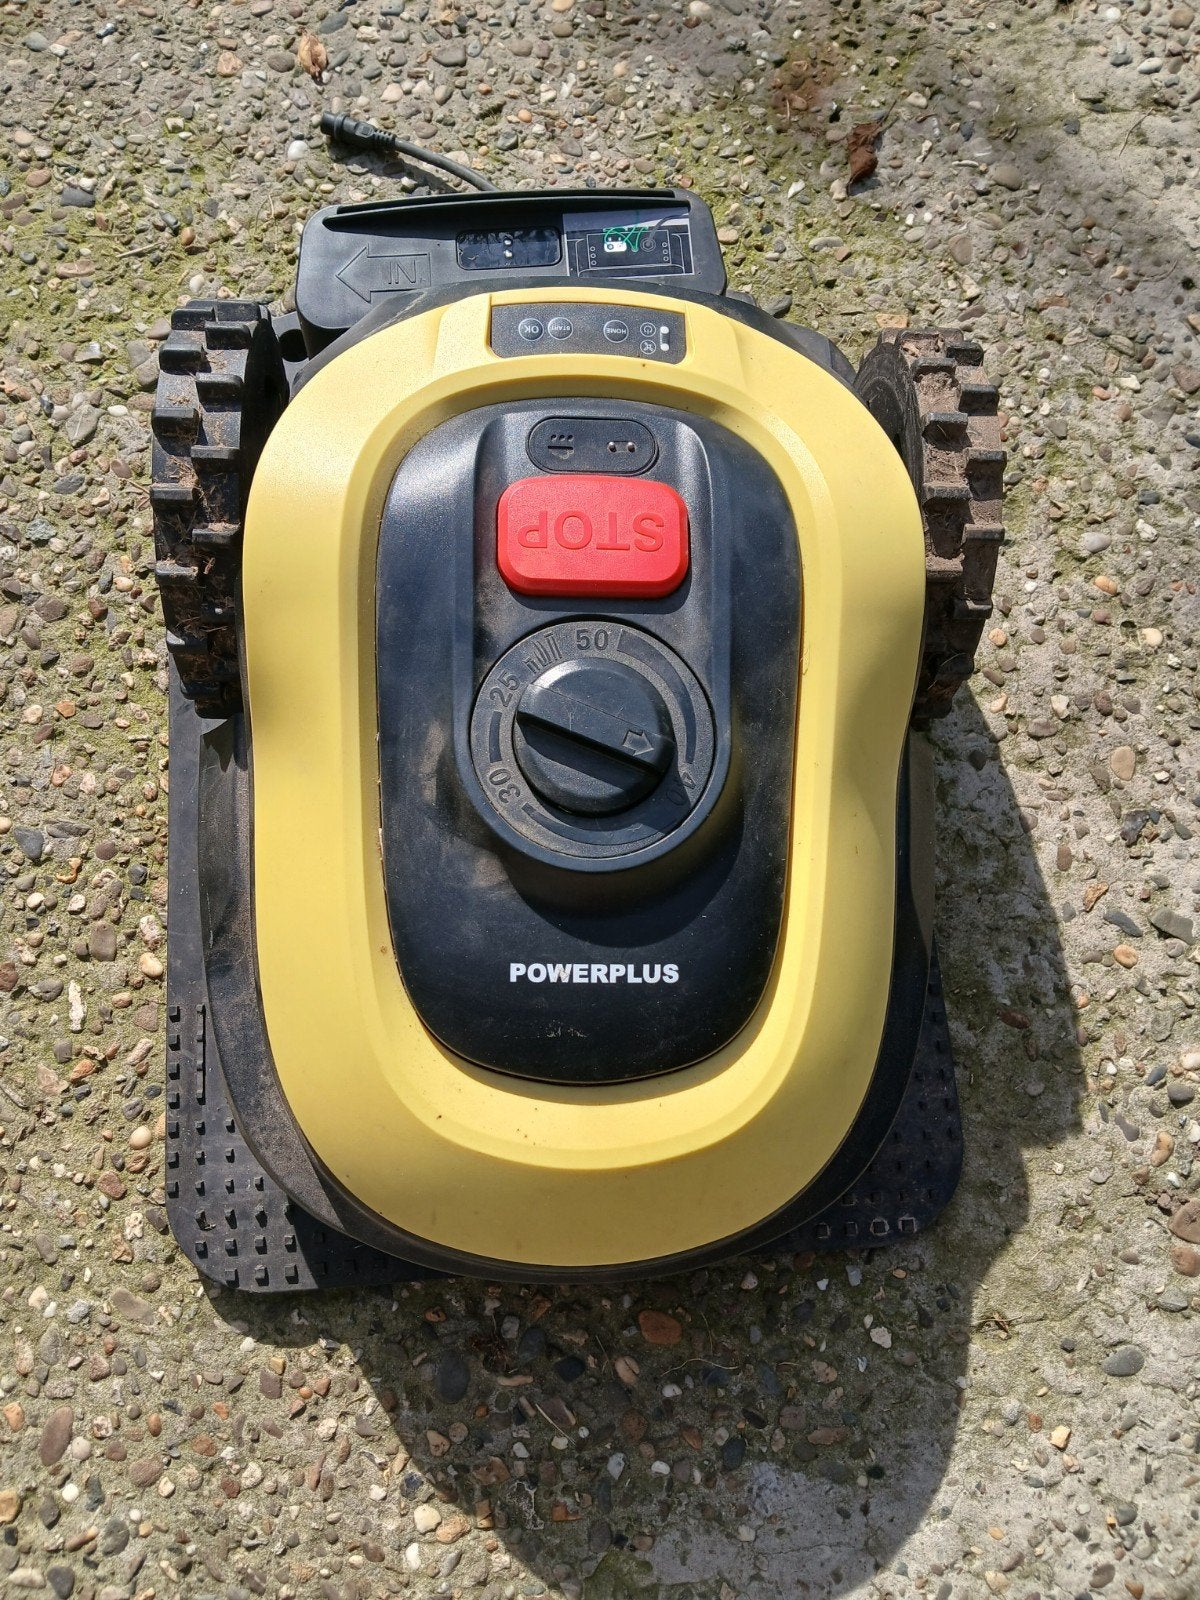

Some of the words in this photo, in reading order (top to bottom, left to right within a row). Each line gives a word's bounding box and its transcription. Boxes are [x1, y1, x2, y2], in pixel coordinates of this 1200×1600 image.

[386, 259, 417, 285] IN
[523, 325, 540, 334] OK
[605, 327, 627, 335] HOME
[517, 510, 665, 553] STOP
[575, 628, 609, 651] 50
[489, 674, 520, 709] 25
[488, 767, 522, 805] 30
[509, 962, 680, 984] POWERPLUS
